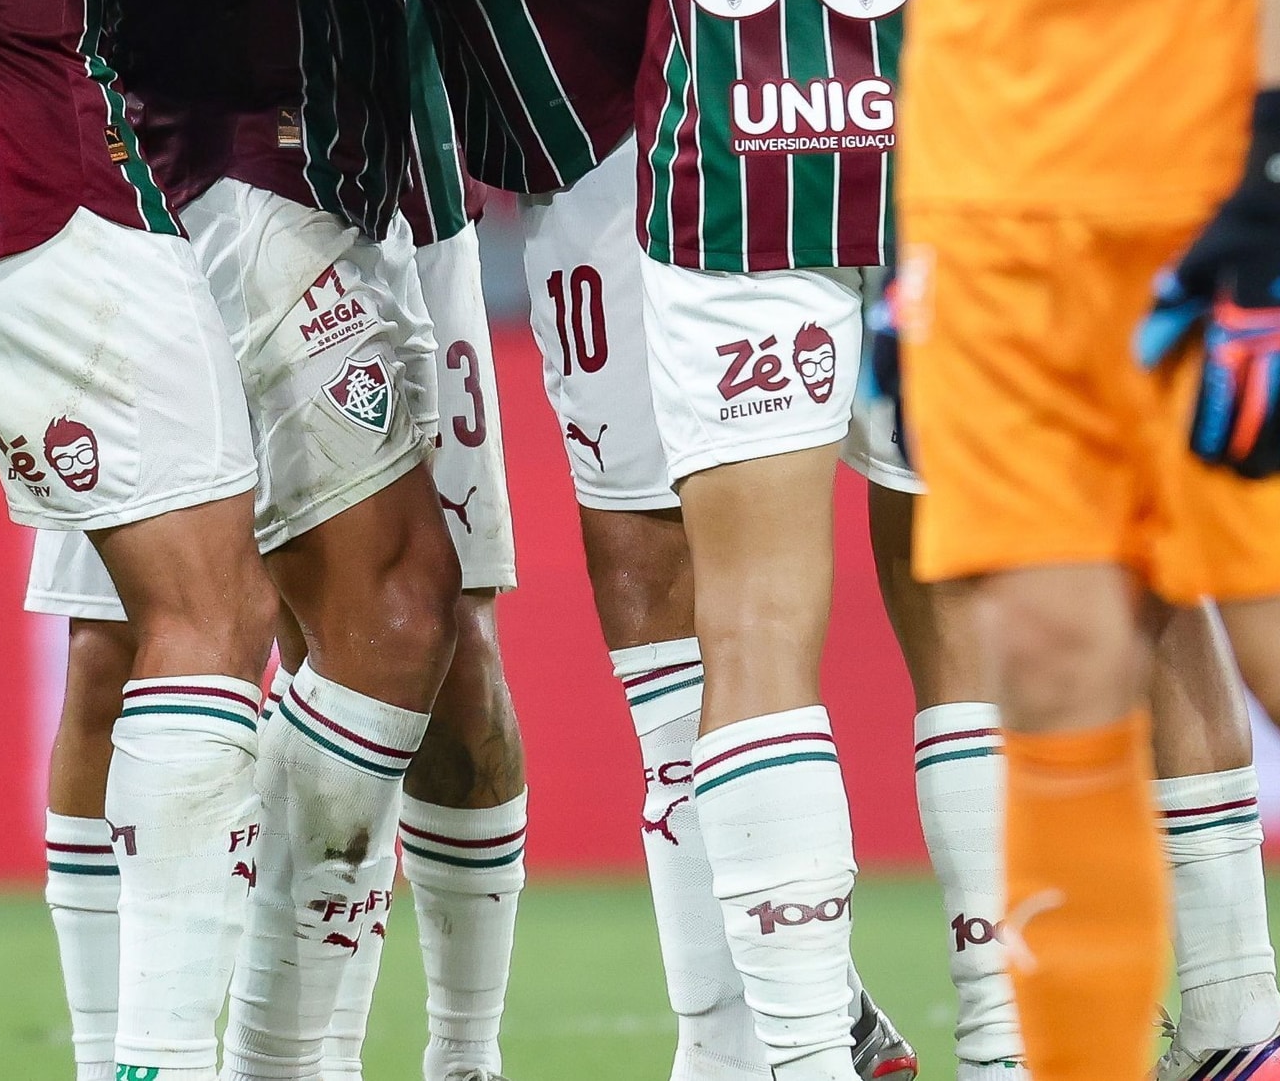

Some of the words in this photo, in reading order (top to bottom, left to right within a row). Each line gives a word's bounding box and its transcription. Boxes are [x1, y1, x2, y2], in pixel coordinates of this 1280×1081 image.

[732, 79, 895, 135] UNIG
[734, 136, 841, 152] UNIVERSIDADE
[841, 134, 895, 150] IGUAÇU
[299, 297, 368, 342] MEGA
[317, 320, 365, 347] SEGUROS
[546, 264, 609, 376] 10
[715, 334, 792, 402] Zé
[720, 394, 794, 421] DELIVERY
